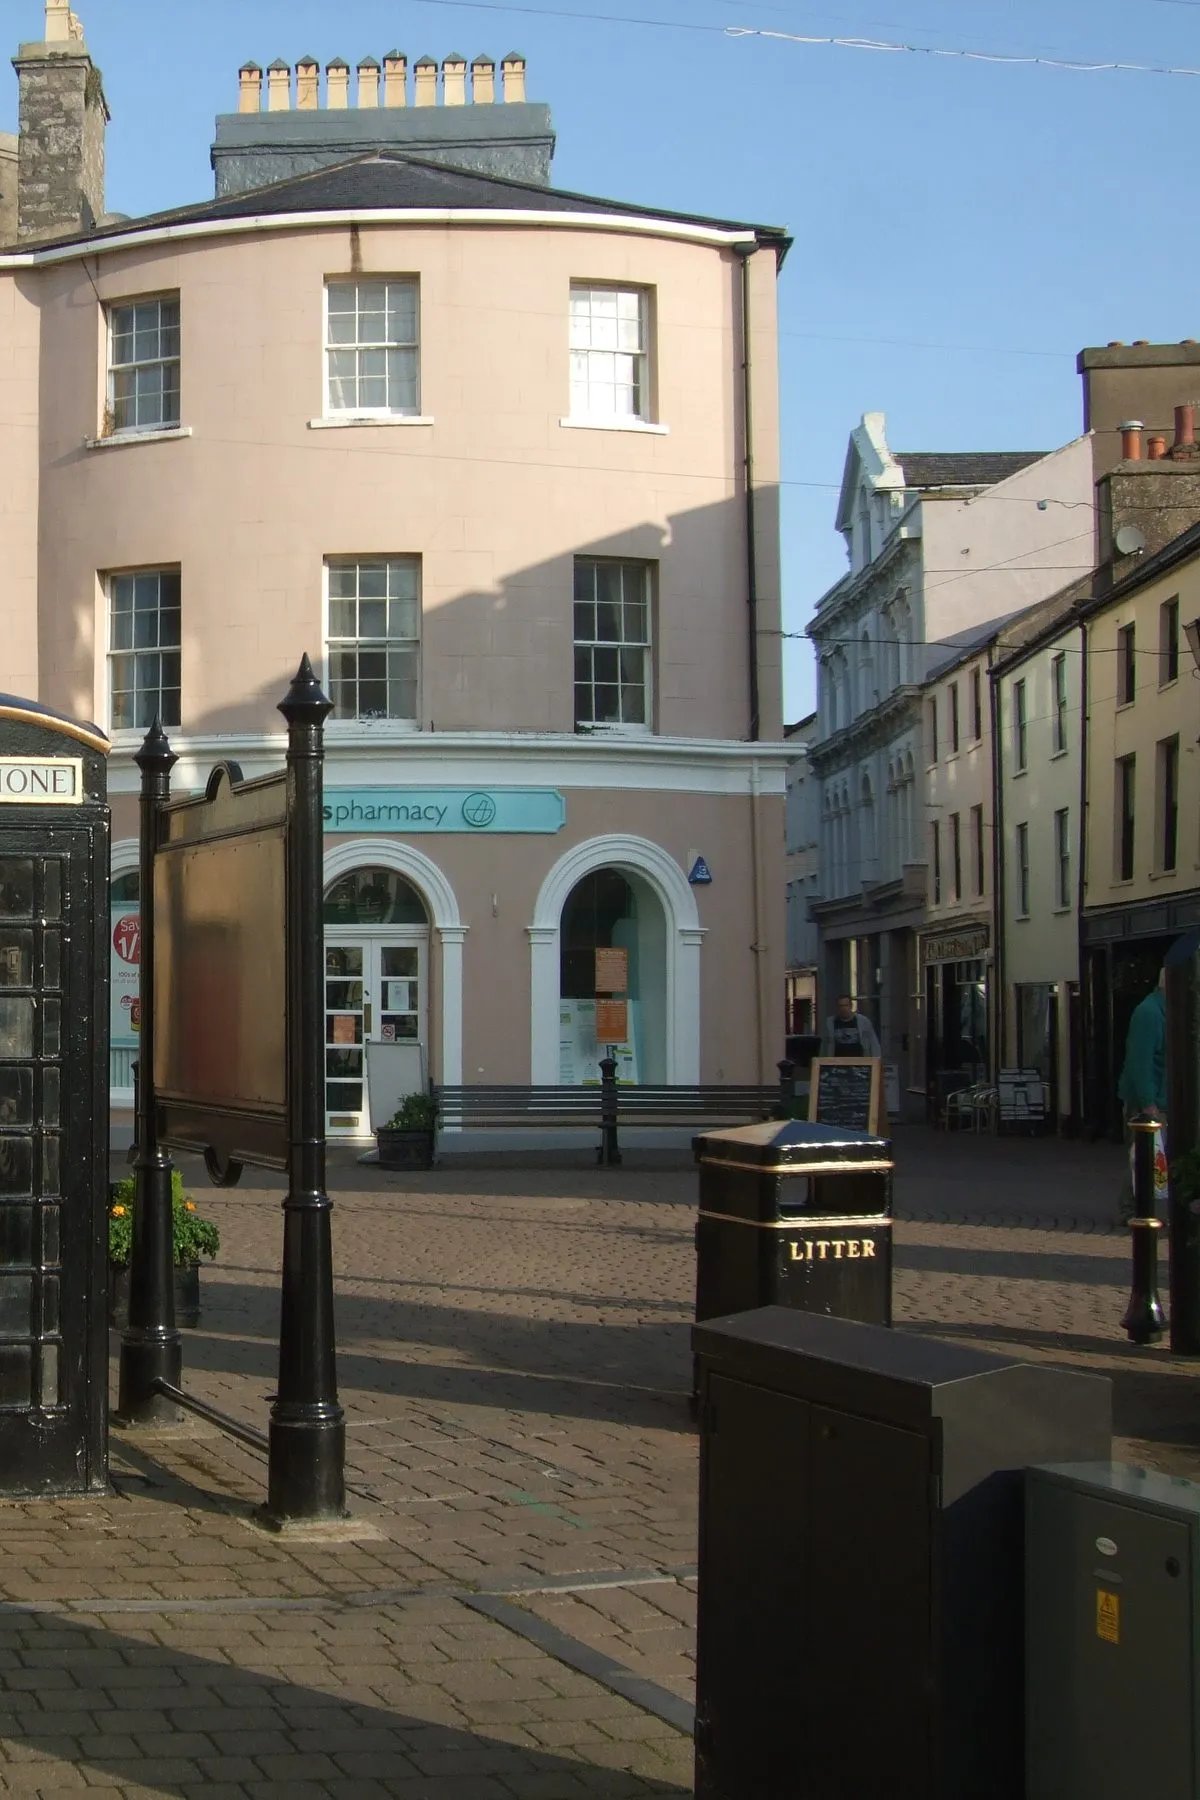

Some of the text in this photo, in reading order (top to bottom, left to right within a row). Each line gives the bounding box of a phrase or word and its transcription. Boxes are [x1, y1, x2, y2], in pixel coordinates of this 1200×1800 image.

[120, 920, 140, 932] Sav
[118, 933, 140, 960] 1/
[789, 1239, 876, 1260] LITTER
